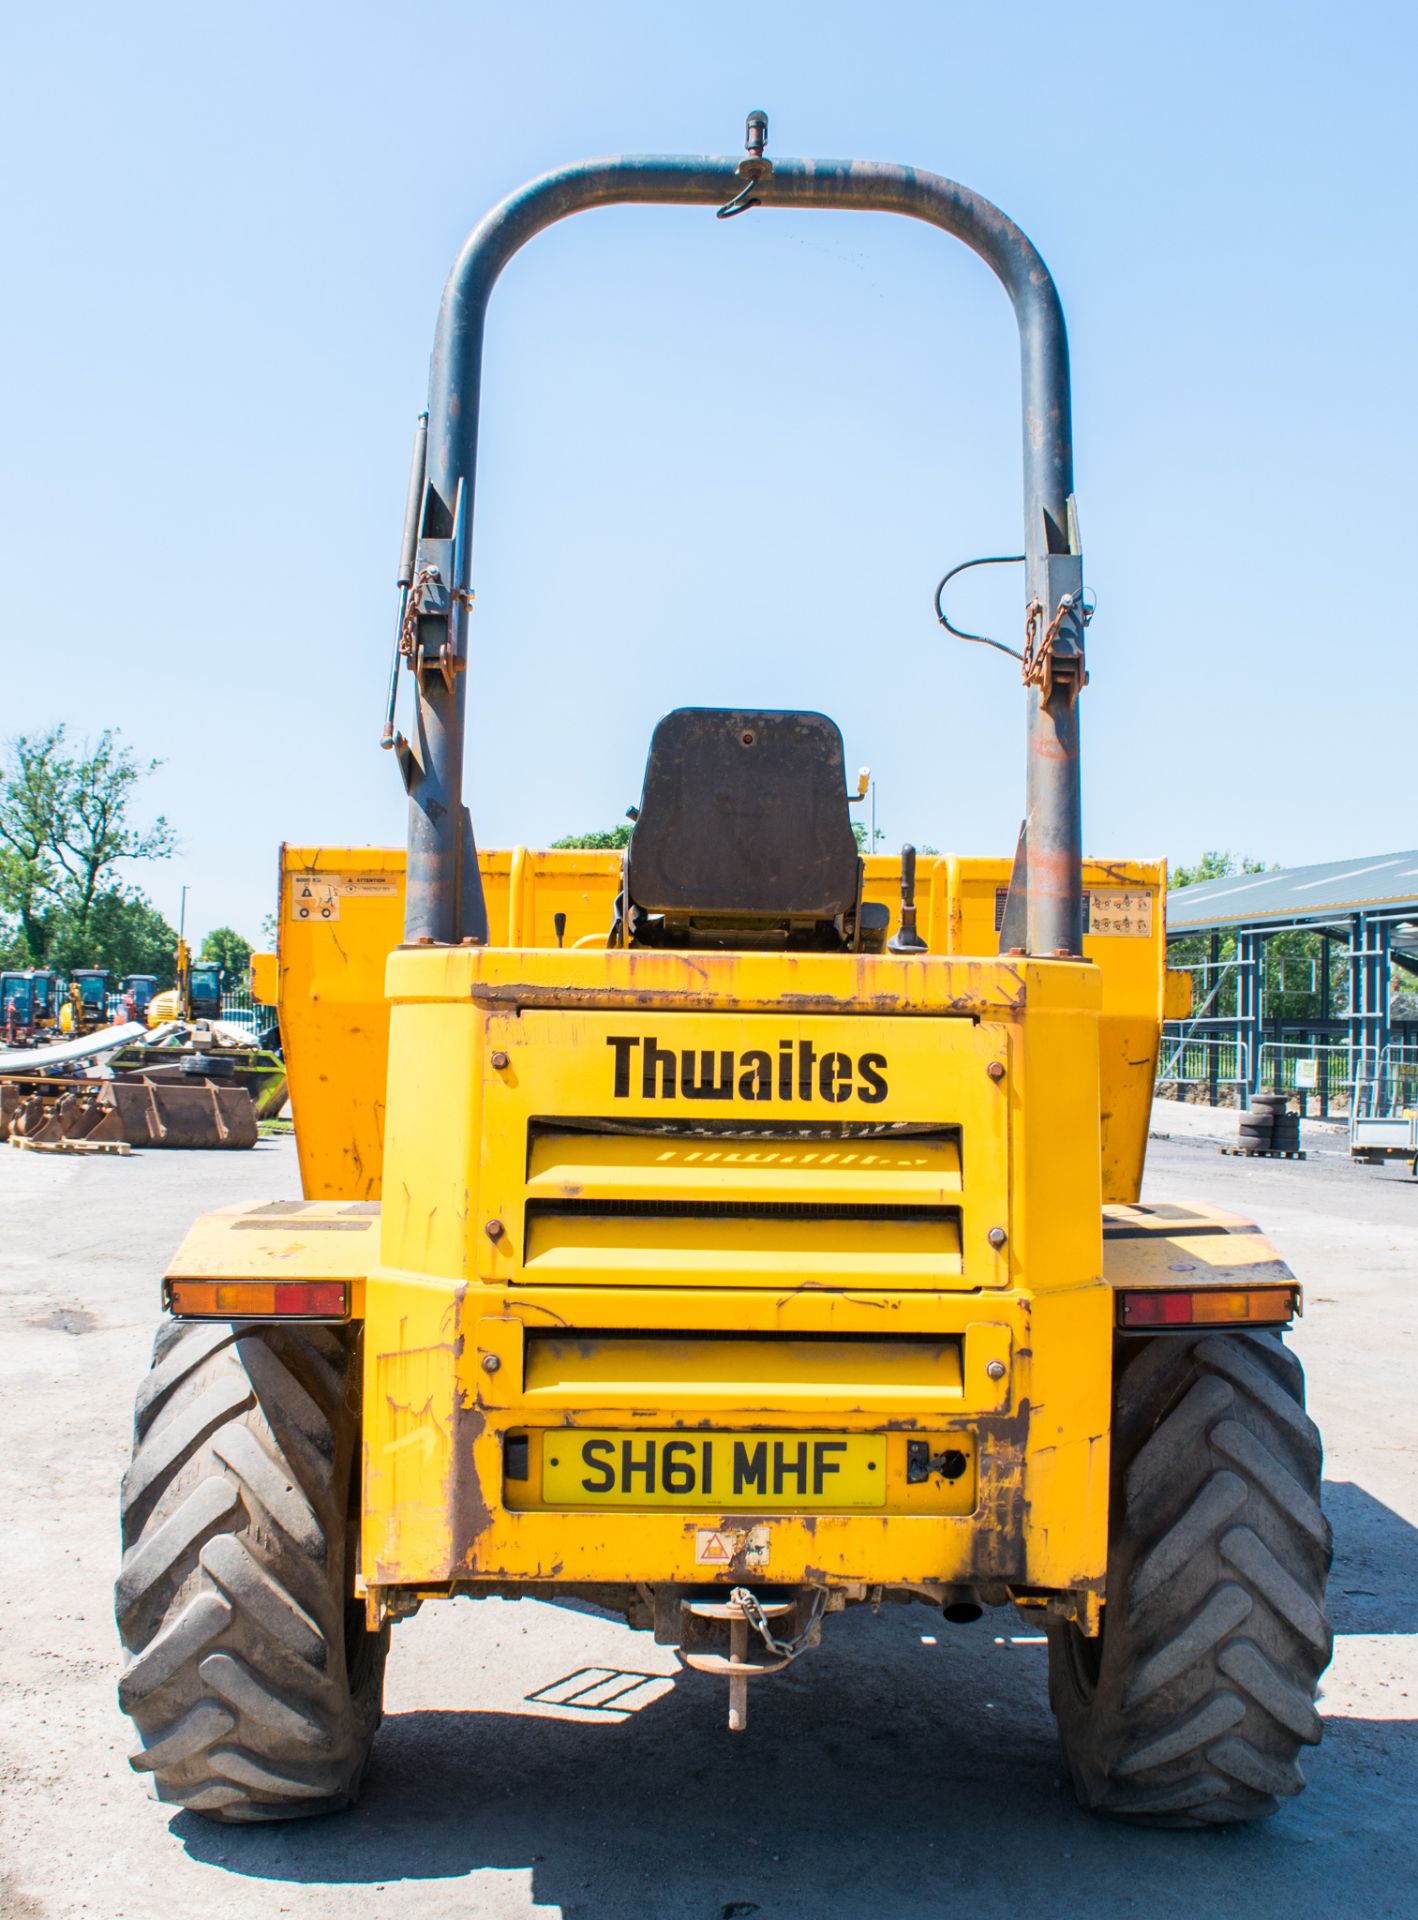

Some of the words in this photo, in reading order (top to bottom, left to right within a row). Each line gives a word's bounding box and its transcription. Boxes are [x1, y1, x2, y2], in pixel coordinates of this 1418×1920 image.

[606, 1036, 888, 1104] Thwaites
[581, 1439, 712, 1494] SH61
[733, 1441, 847, 1495] MHF
